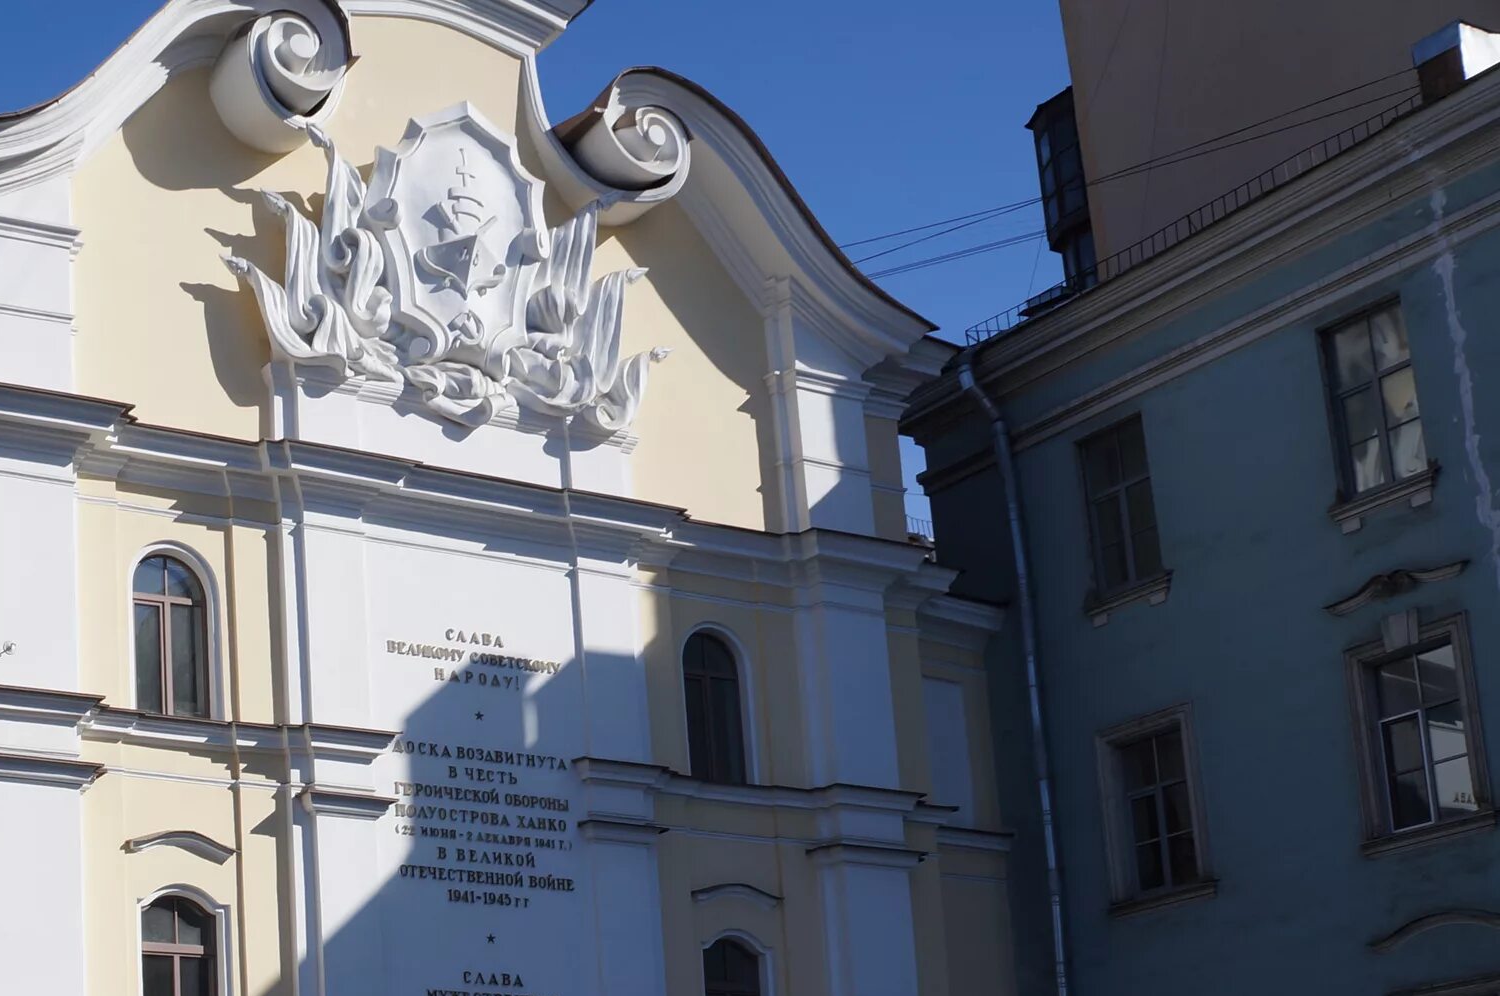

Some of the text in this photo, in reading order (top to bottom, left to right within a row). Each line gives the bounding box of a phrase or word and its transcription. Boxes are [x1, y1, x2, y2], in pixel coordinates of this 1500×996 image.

[445, 628, 504, 648] СЛАВА
[386, 639, 561, 675] ВЕЛИКОМУ СОВЕТСКОМУ
[434, 667, 520, 691] НАРОДУ!
[392, 739, 568, 771] ДОСКА ВОЗДВИГНУТА
[448, 766, 518, 785] В ЧЕСТЬ
[394, 781, 569, 812] ГЕРОИЧЕСКОЙ ОБОРОНЫ
[395, 803, 567, 832] ПОЛУОСТРОВА ХАНКО
[420, 825, 457, 840] ИЮНЯ
[437, 846, 536, 868] В ВЕЛИКОЙ
[400, 864, 575, 892] ОТЕЧЕСТВЕННОЙ ВОЙНЕ
[463, 970, 524, 988] СЛАВА
